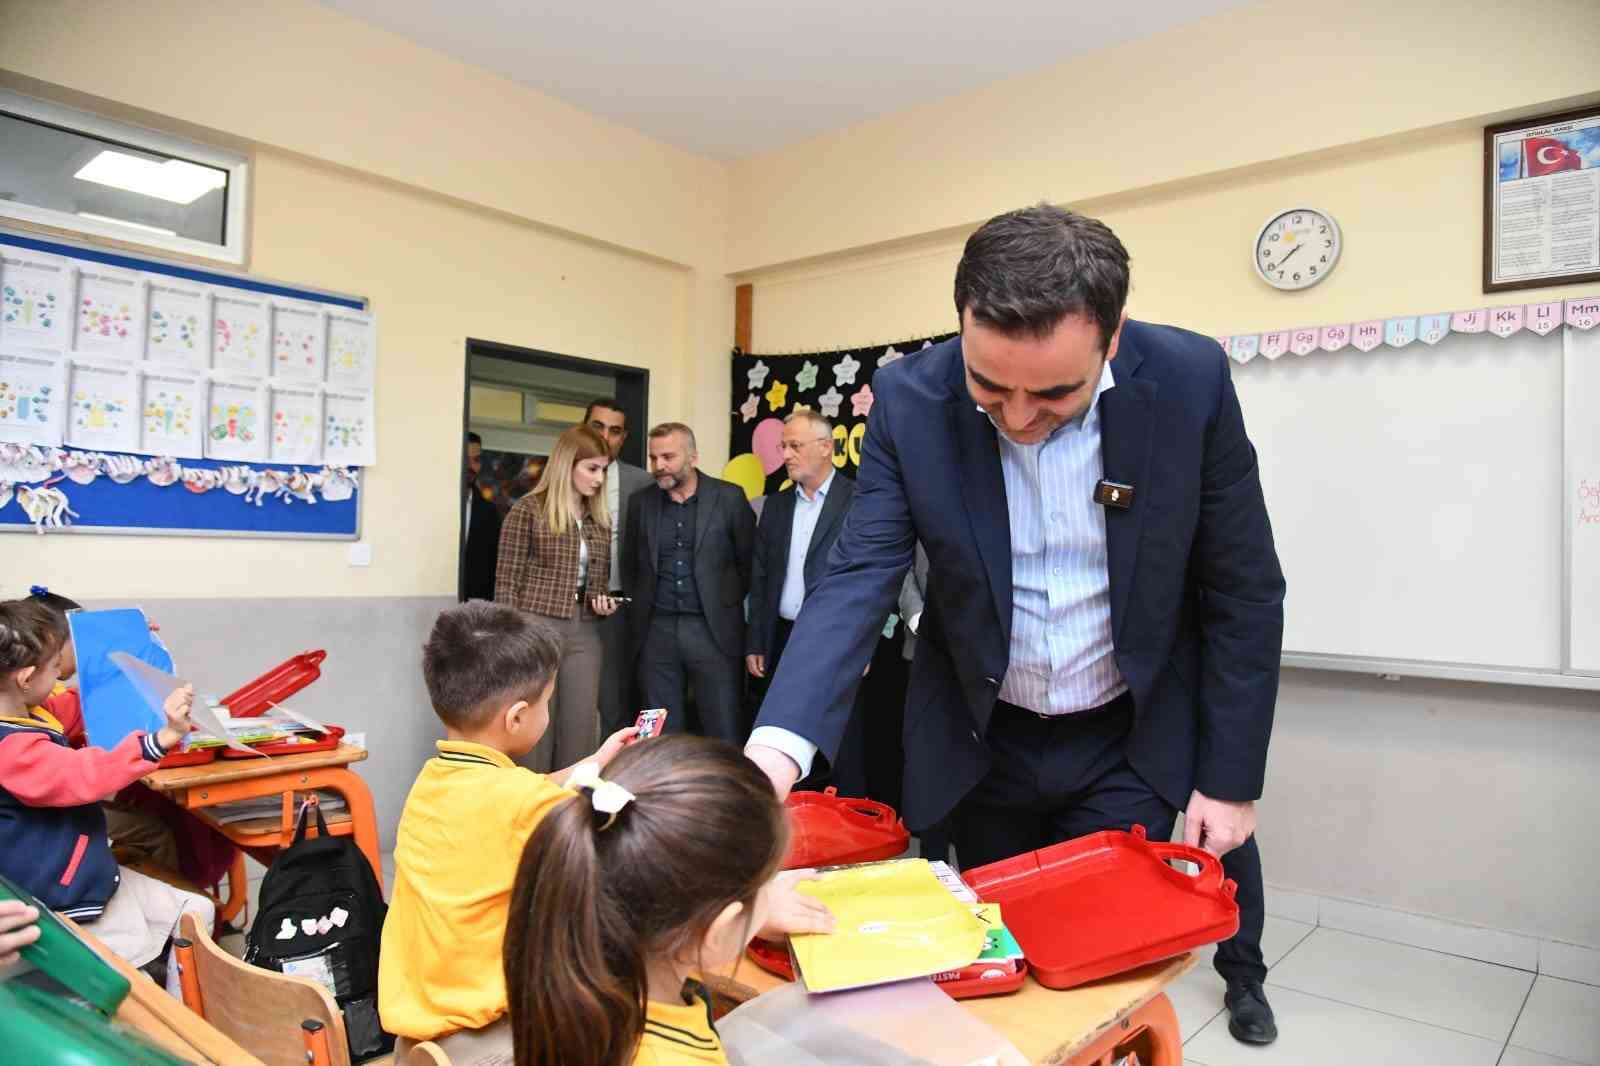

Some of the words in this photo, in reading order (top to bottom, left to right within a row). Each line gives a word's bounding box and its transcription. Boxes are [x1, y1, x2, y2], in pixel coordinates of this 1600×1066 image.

[1292, 216, 1302, 224] 12
[1320, 225, 1328, 234] 2
[1268, 233, 1280, 241] 10
[1324, 240, 1332, 248] 3
[1263, 249, 1271, 257] 9
[1320, 255, 1327, 263] 4
[1267, 262, 1276, 271] 8
[1309, 266, 1317, 275] 5
[1277, 270, 1285, 279] 7
[1292, 272, 1301, 280] 6
[1571, 303, 1600, 314] Mm
[1463, 312, 1476, 325] Jj
[1496, 311, 1516, 321] Kk
[1537, 321, 1550, 329] 15
[1360, 325, 1377, 336] Hh
[1267, 334, 1281, 345] Ff
[1296, 332, 1312, 344] Gg
